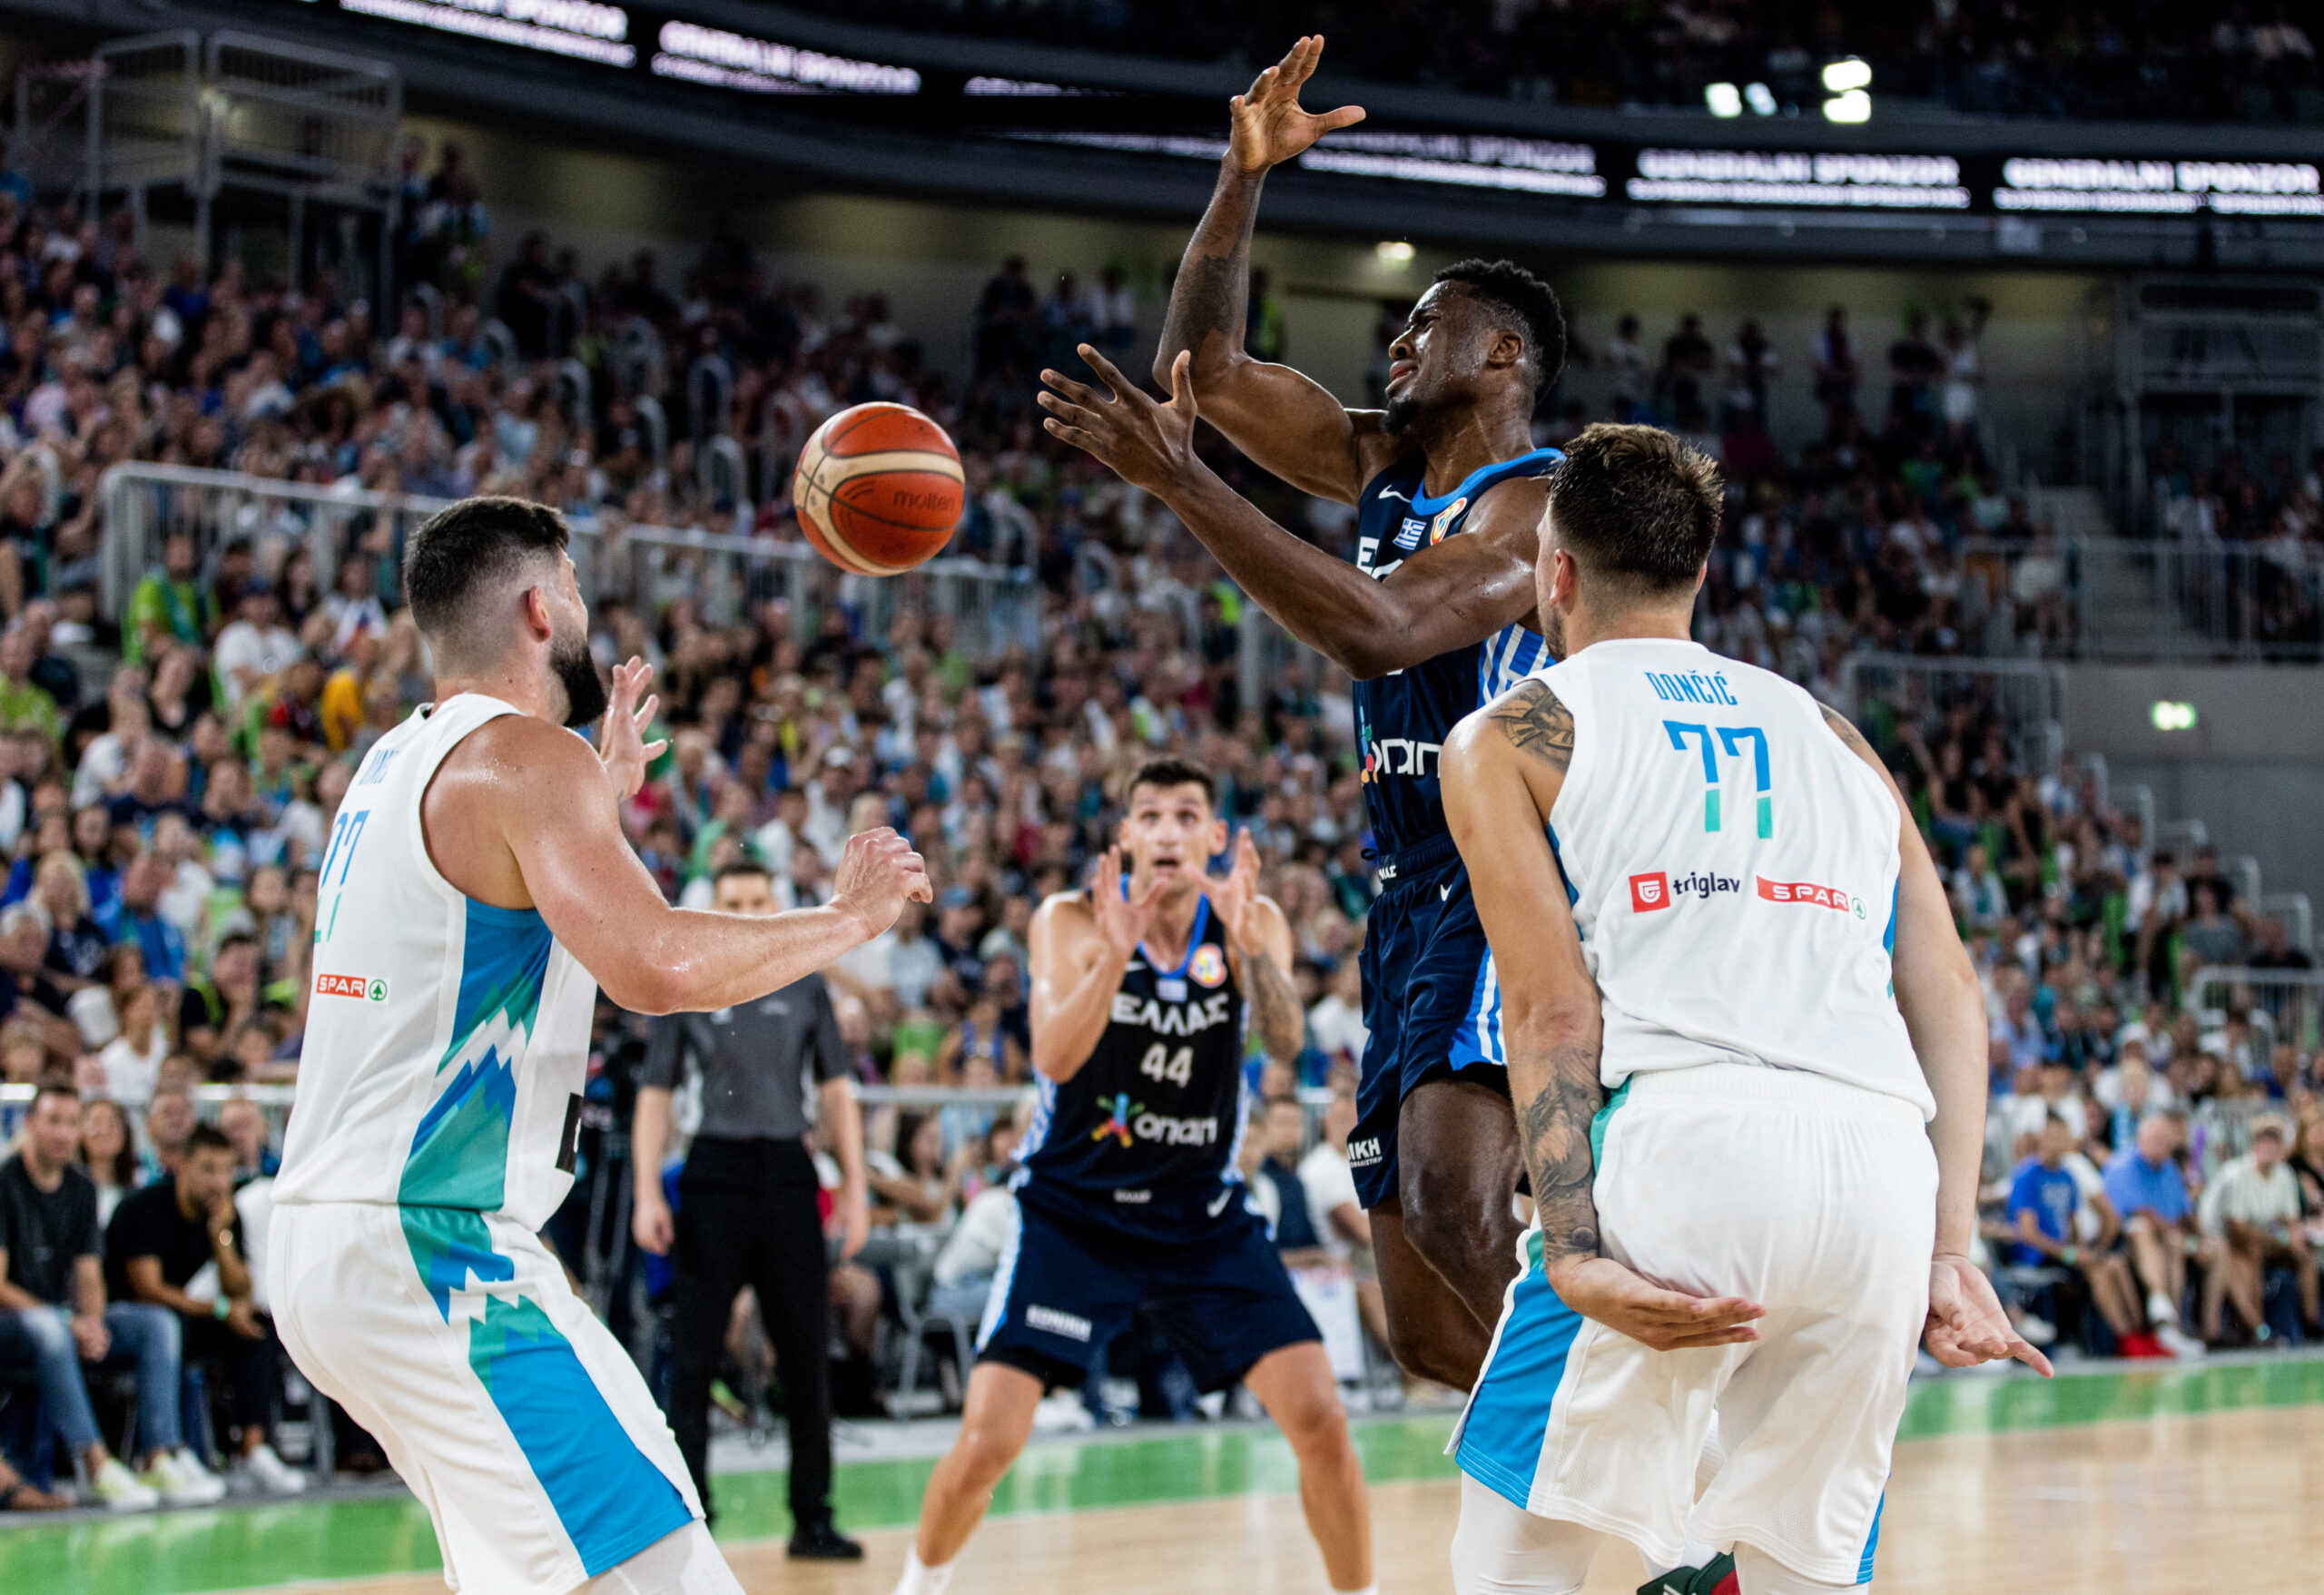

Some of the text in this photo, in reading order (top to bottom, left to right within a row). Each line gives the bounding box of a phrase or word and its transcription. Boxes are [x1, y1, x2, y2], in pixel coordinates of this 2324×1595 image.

[1644, 669, 1738, 705] DONČIĆ
[1663, 720, 1773, 840] 77
[1673, 871, 1740, 899] triglav
[1773, 885, 1850, 908] SPAR
[319, 976, 364, 995] SPAR
[1140, 1041, 1194, 1088] 44
